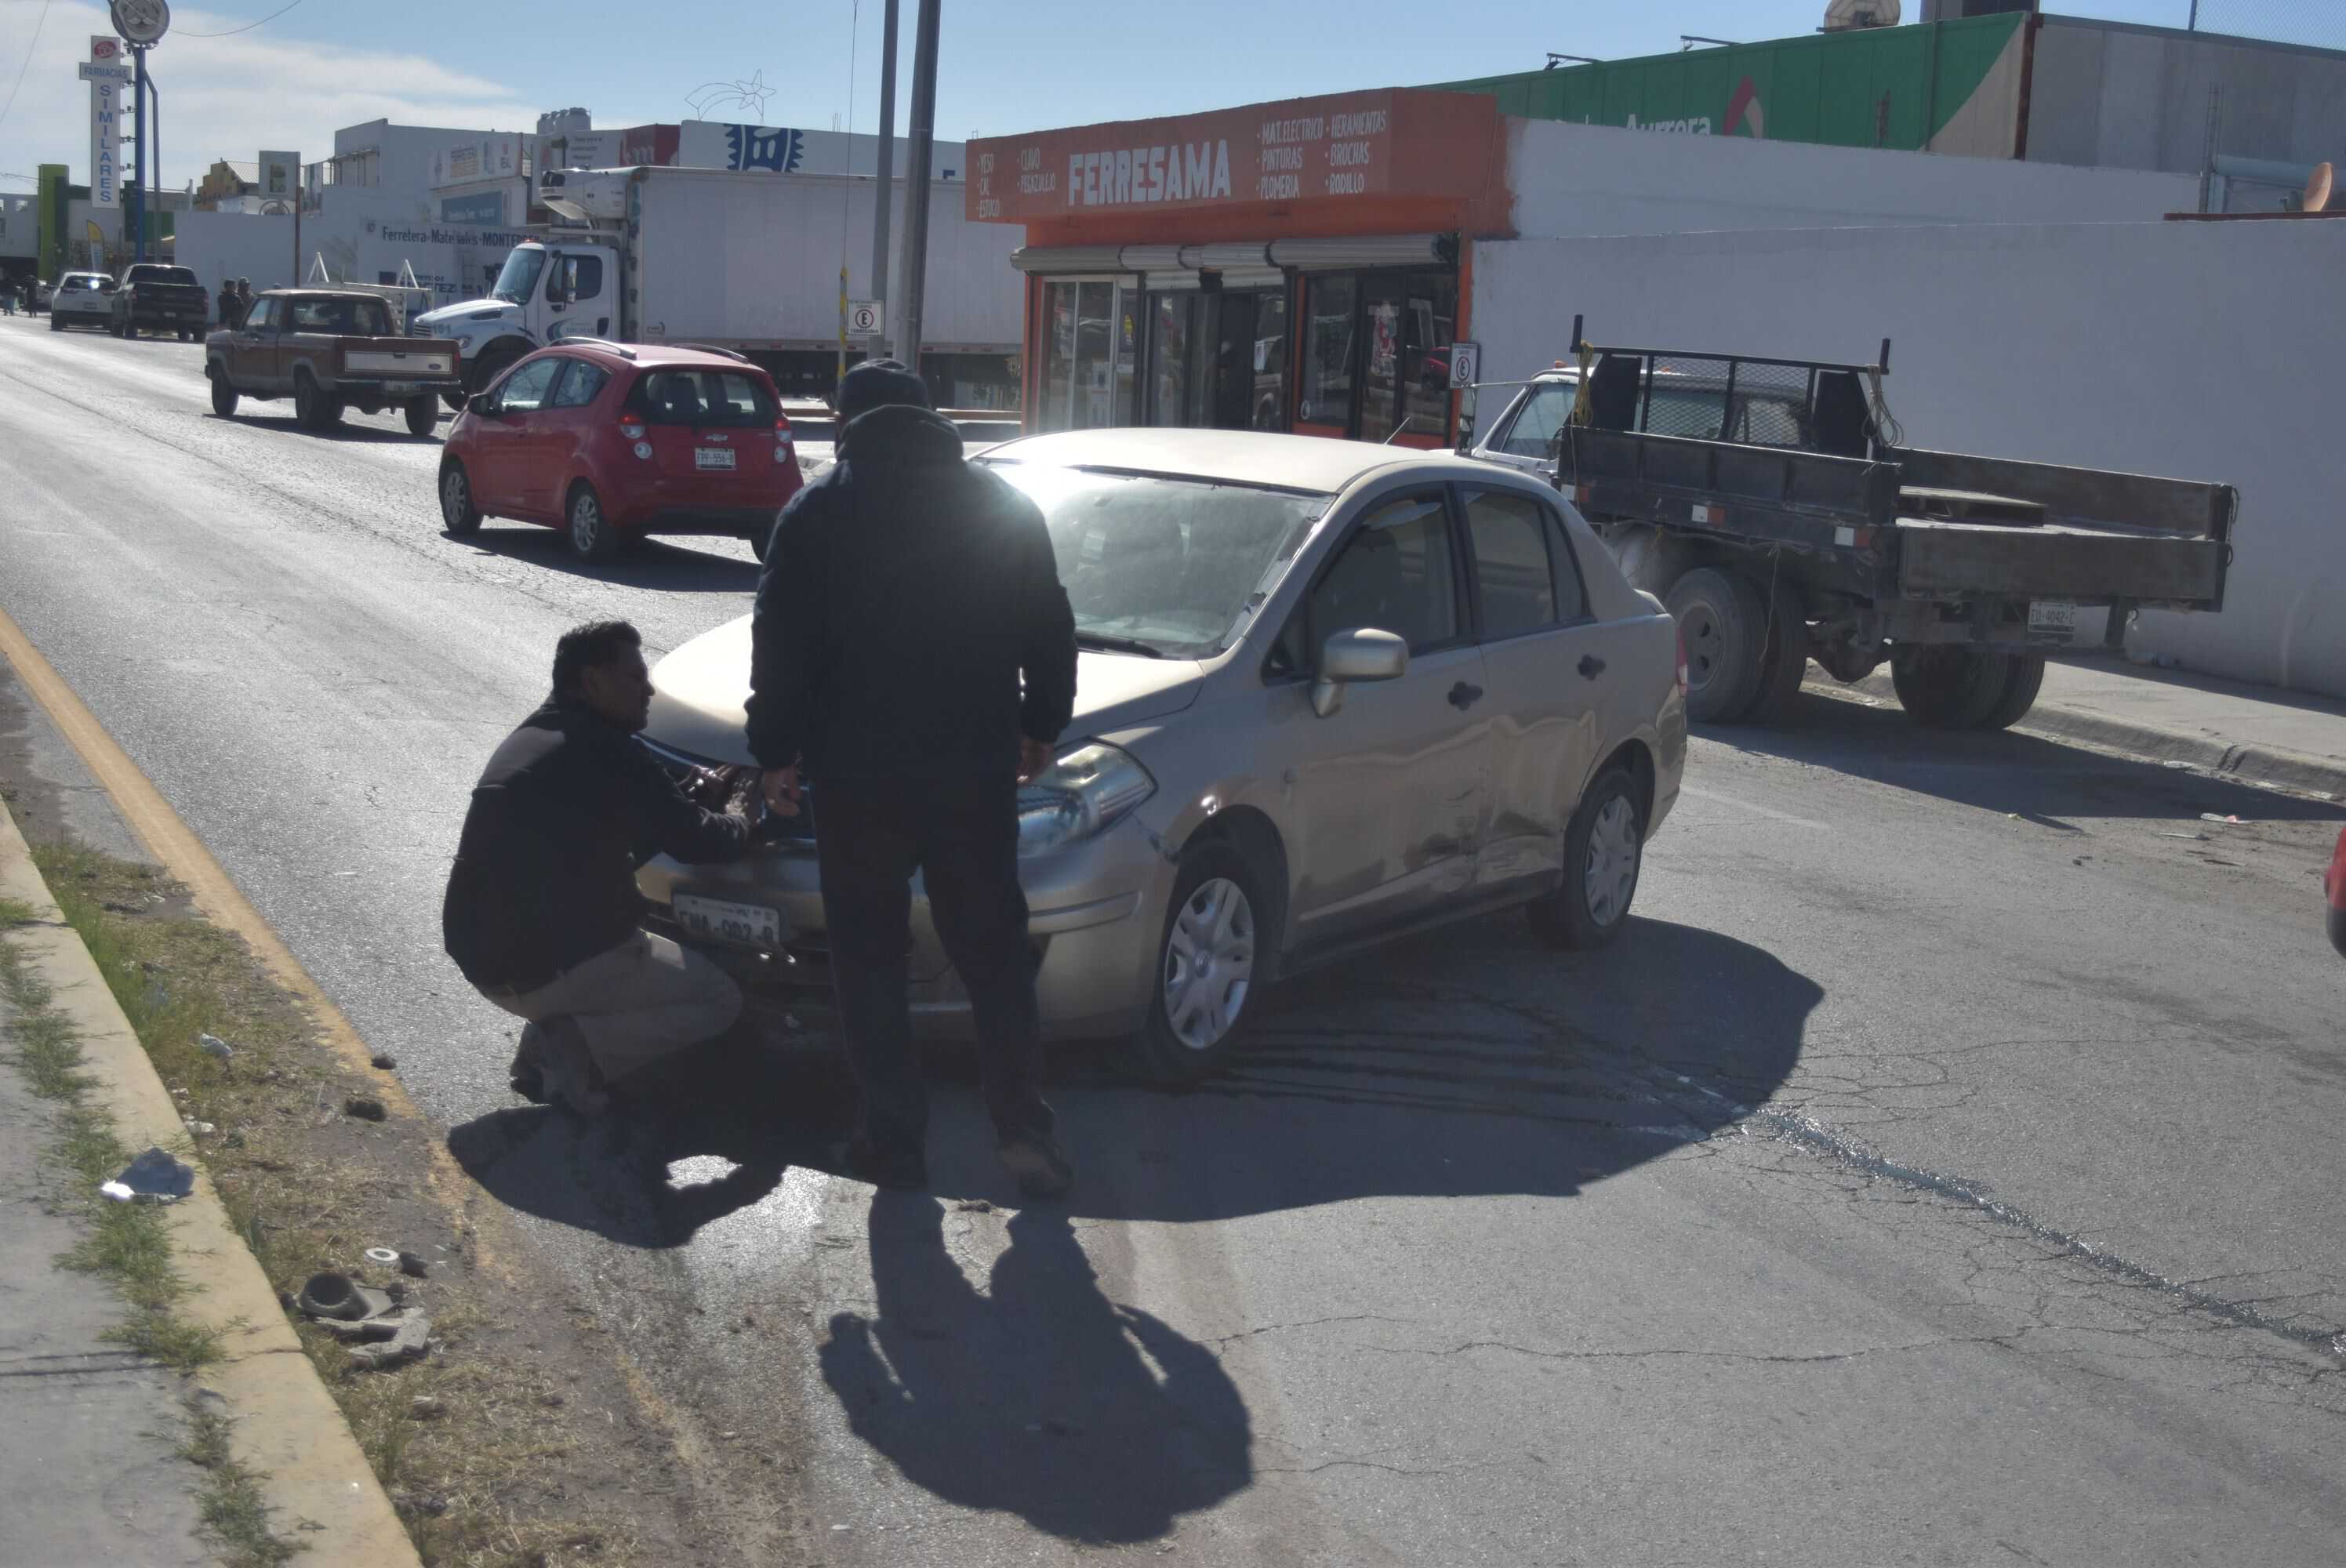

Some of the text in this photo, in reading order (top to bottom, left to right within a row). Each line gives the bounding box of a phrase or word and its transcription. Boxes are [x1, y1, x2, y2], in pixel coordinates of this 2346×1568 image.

[84, 67, 128, 78] FARMACIAS
[99, 85, 113, 202] SIMILARES
[1330, 141, 1370, 167] BROCHAS
[979, 153, 995, 174] YESO
[1021, 147, 1041, 172] CLAVO
[1262, 147, 1303, 172] PINTURAS
[979, 175, 990, 196] CAL
[1068, 139, 1231, 207] FERRESAMA
[1329, 172, 1365, 195] RODILLO
[1260, 173, 1300, 200] PLOMERIA
[979, 198, 1000, 220] ESTUCO
